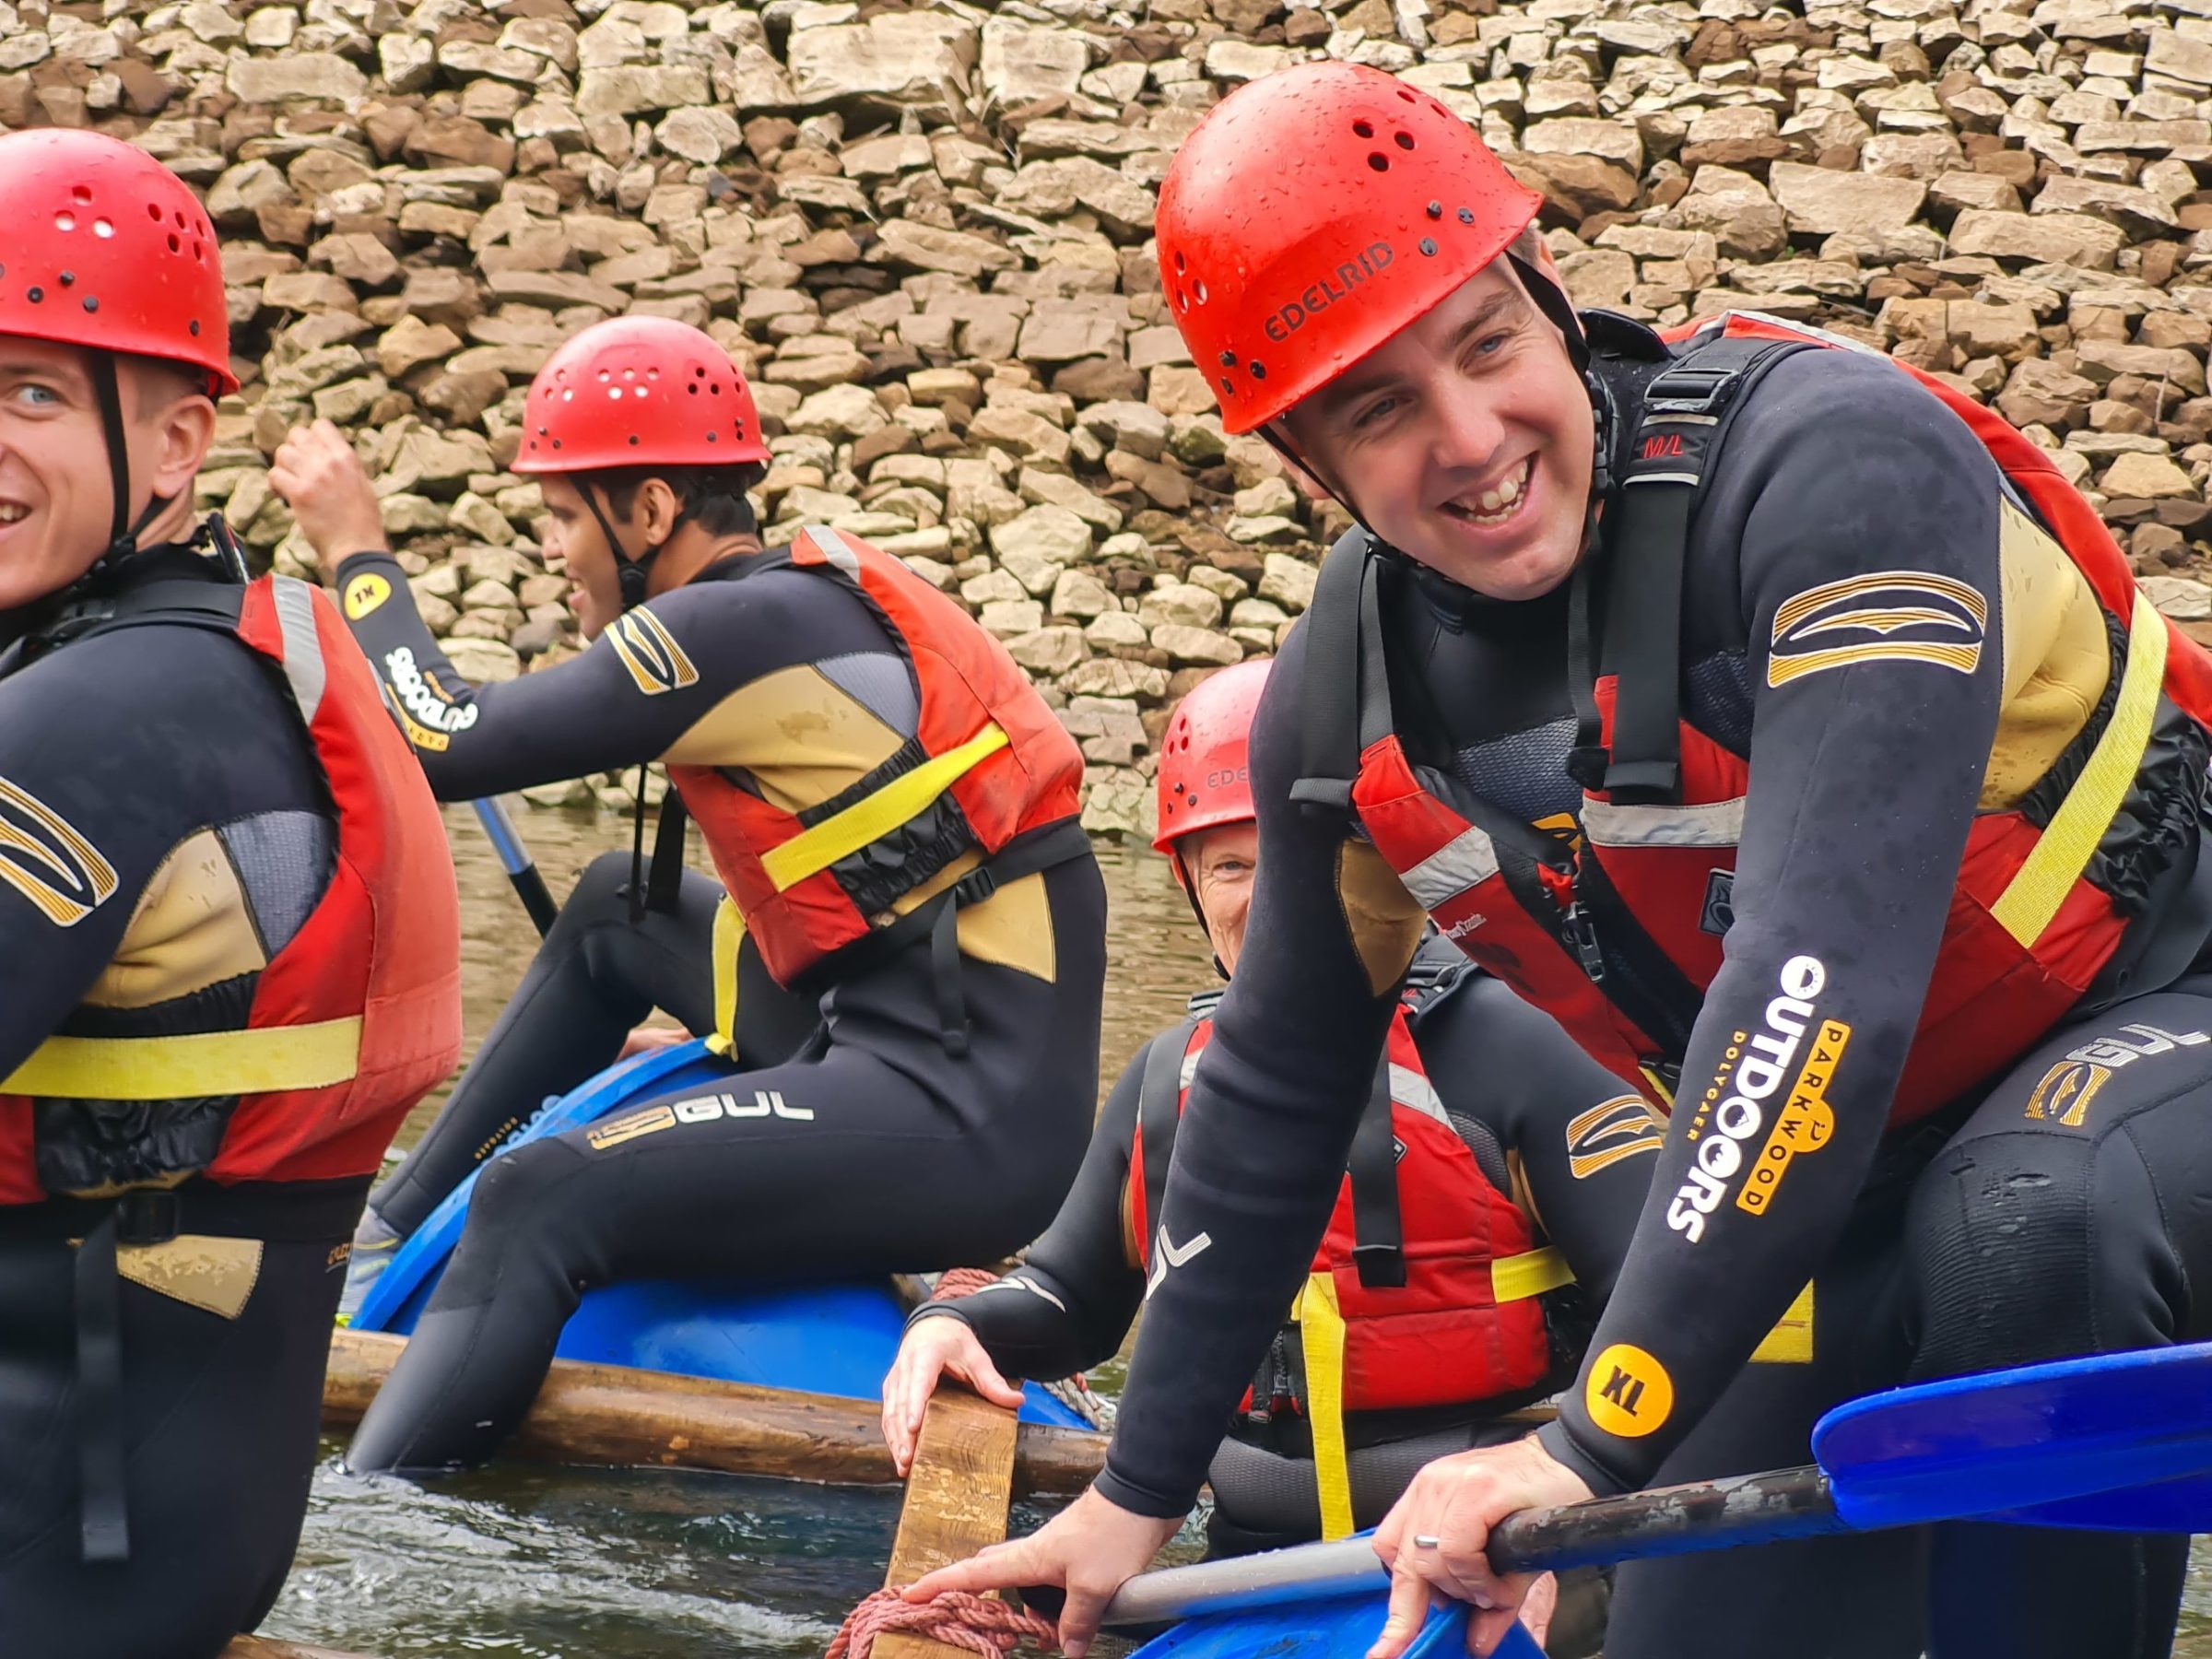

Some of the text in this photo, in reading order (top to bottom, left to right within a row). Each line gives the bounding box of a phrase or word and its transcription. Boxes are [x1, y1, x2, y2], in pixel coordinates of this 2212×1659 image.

[1265, 241, 1394, 342] EDELRID
[1643, 434, 1684, 459] M/L
[2065, 1023, 2211, 1067] GUL
[674, 1090, 815, 1124] GUL
[1666, 955, 1826, 1244] OUTDOORS
[1687, 1030, 1747, 1141] DOLYGAER
[1745, 1027, 1843, 1206] PARKWOOD
[1600, 1365, 1645, 1418] XL
